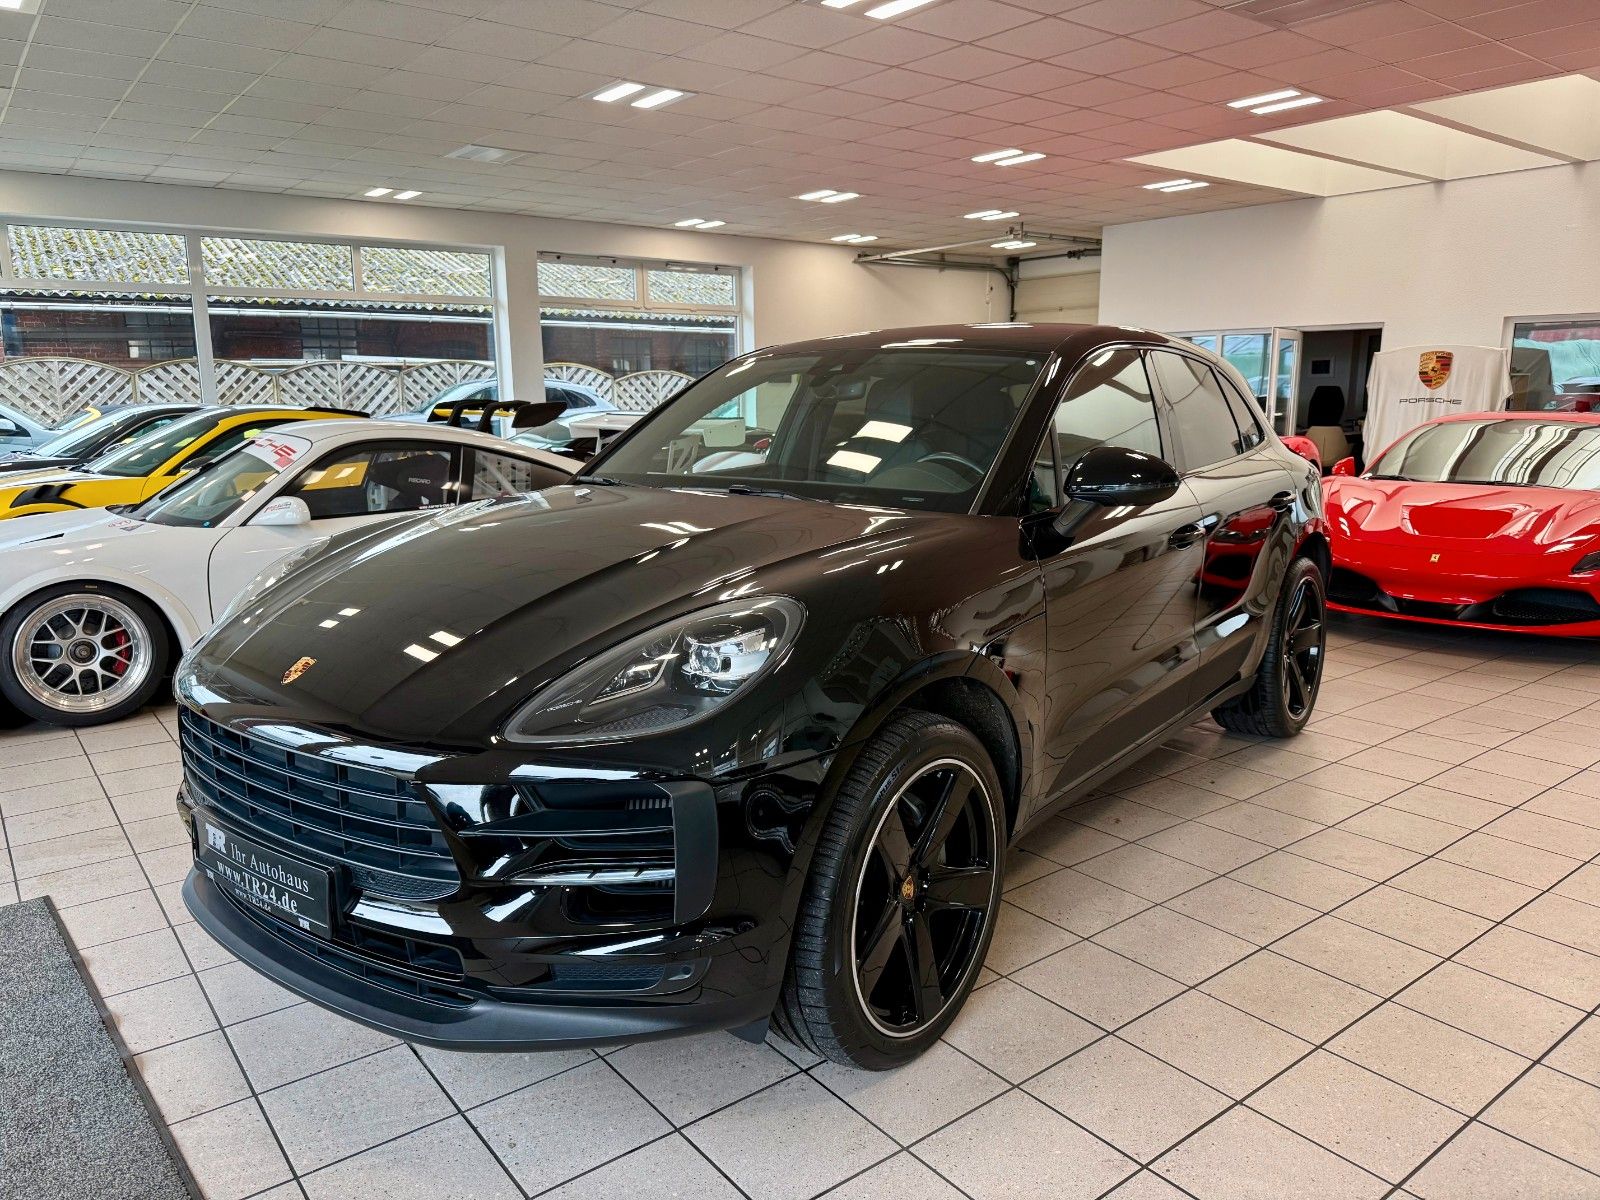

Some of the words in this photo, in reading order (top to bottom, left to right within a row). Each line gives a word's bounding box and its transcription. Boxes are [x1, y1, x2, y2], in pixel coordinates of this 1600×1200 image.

[1399, 397, 1463, 405] PORSCHE
[216, 860, 298, 913] www.TR24.de
[230, 842, 246, 865] Ihr
[250, 853, 309, 893] Autohaus
